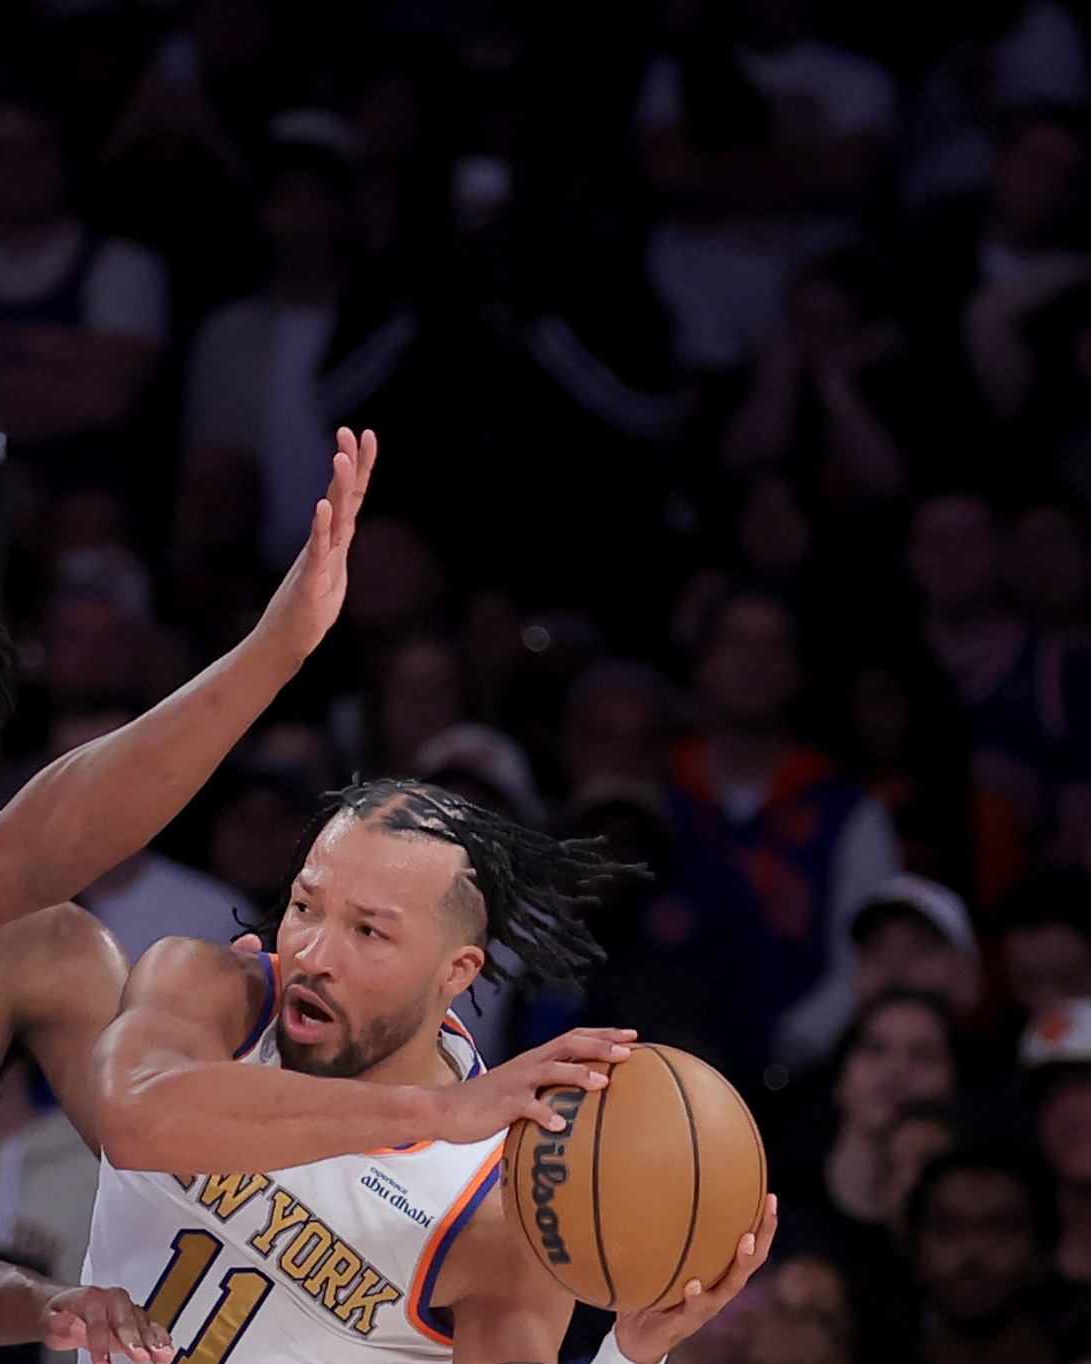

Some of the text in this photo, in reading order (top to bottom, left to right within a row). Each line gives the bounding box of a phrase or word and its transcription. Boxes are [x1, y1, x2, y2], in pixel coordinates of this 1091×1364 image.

[360, 1175, 434, 1229] abu dhabi
[530, 1087, 587, 1265] Wilson
[246, 1185, 405, 1340] YORK
